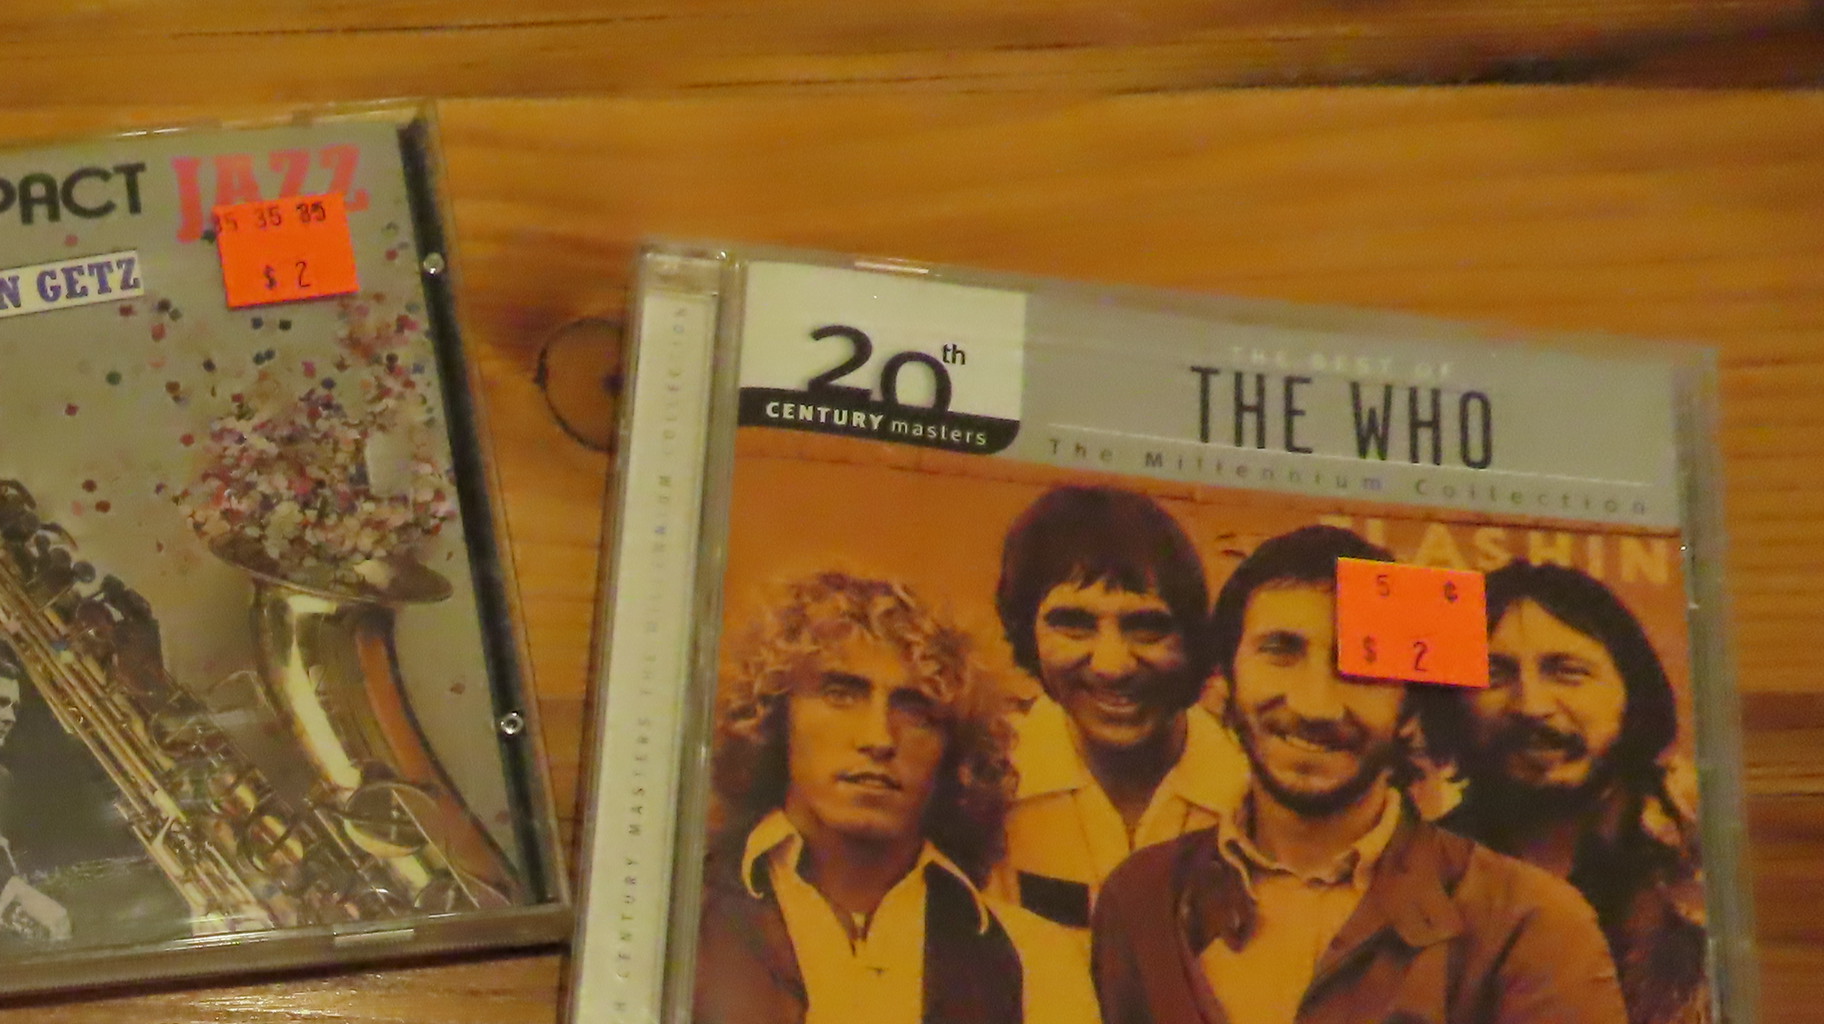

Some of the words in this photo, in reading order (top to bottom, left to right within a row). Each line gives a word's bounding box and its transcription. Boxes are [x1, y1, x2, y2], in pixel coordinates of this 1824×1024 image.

[170, 144, 370, 244] JAZZ
[36, 255, 142, 304] GETZ
[765, 401, 884, 431] CENTURY
[891, 418, 987, 446] masters
[1190, 365, 1313, 455] THE
[1350, 380, 1494, 471] WHO
[1049, 437, 1114, 463] The
[1144, 452, 1384, 492] Millennium
[1415, 477, 1648, 516] Collection
[1412, 641, 1428, 672] 2
